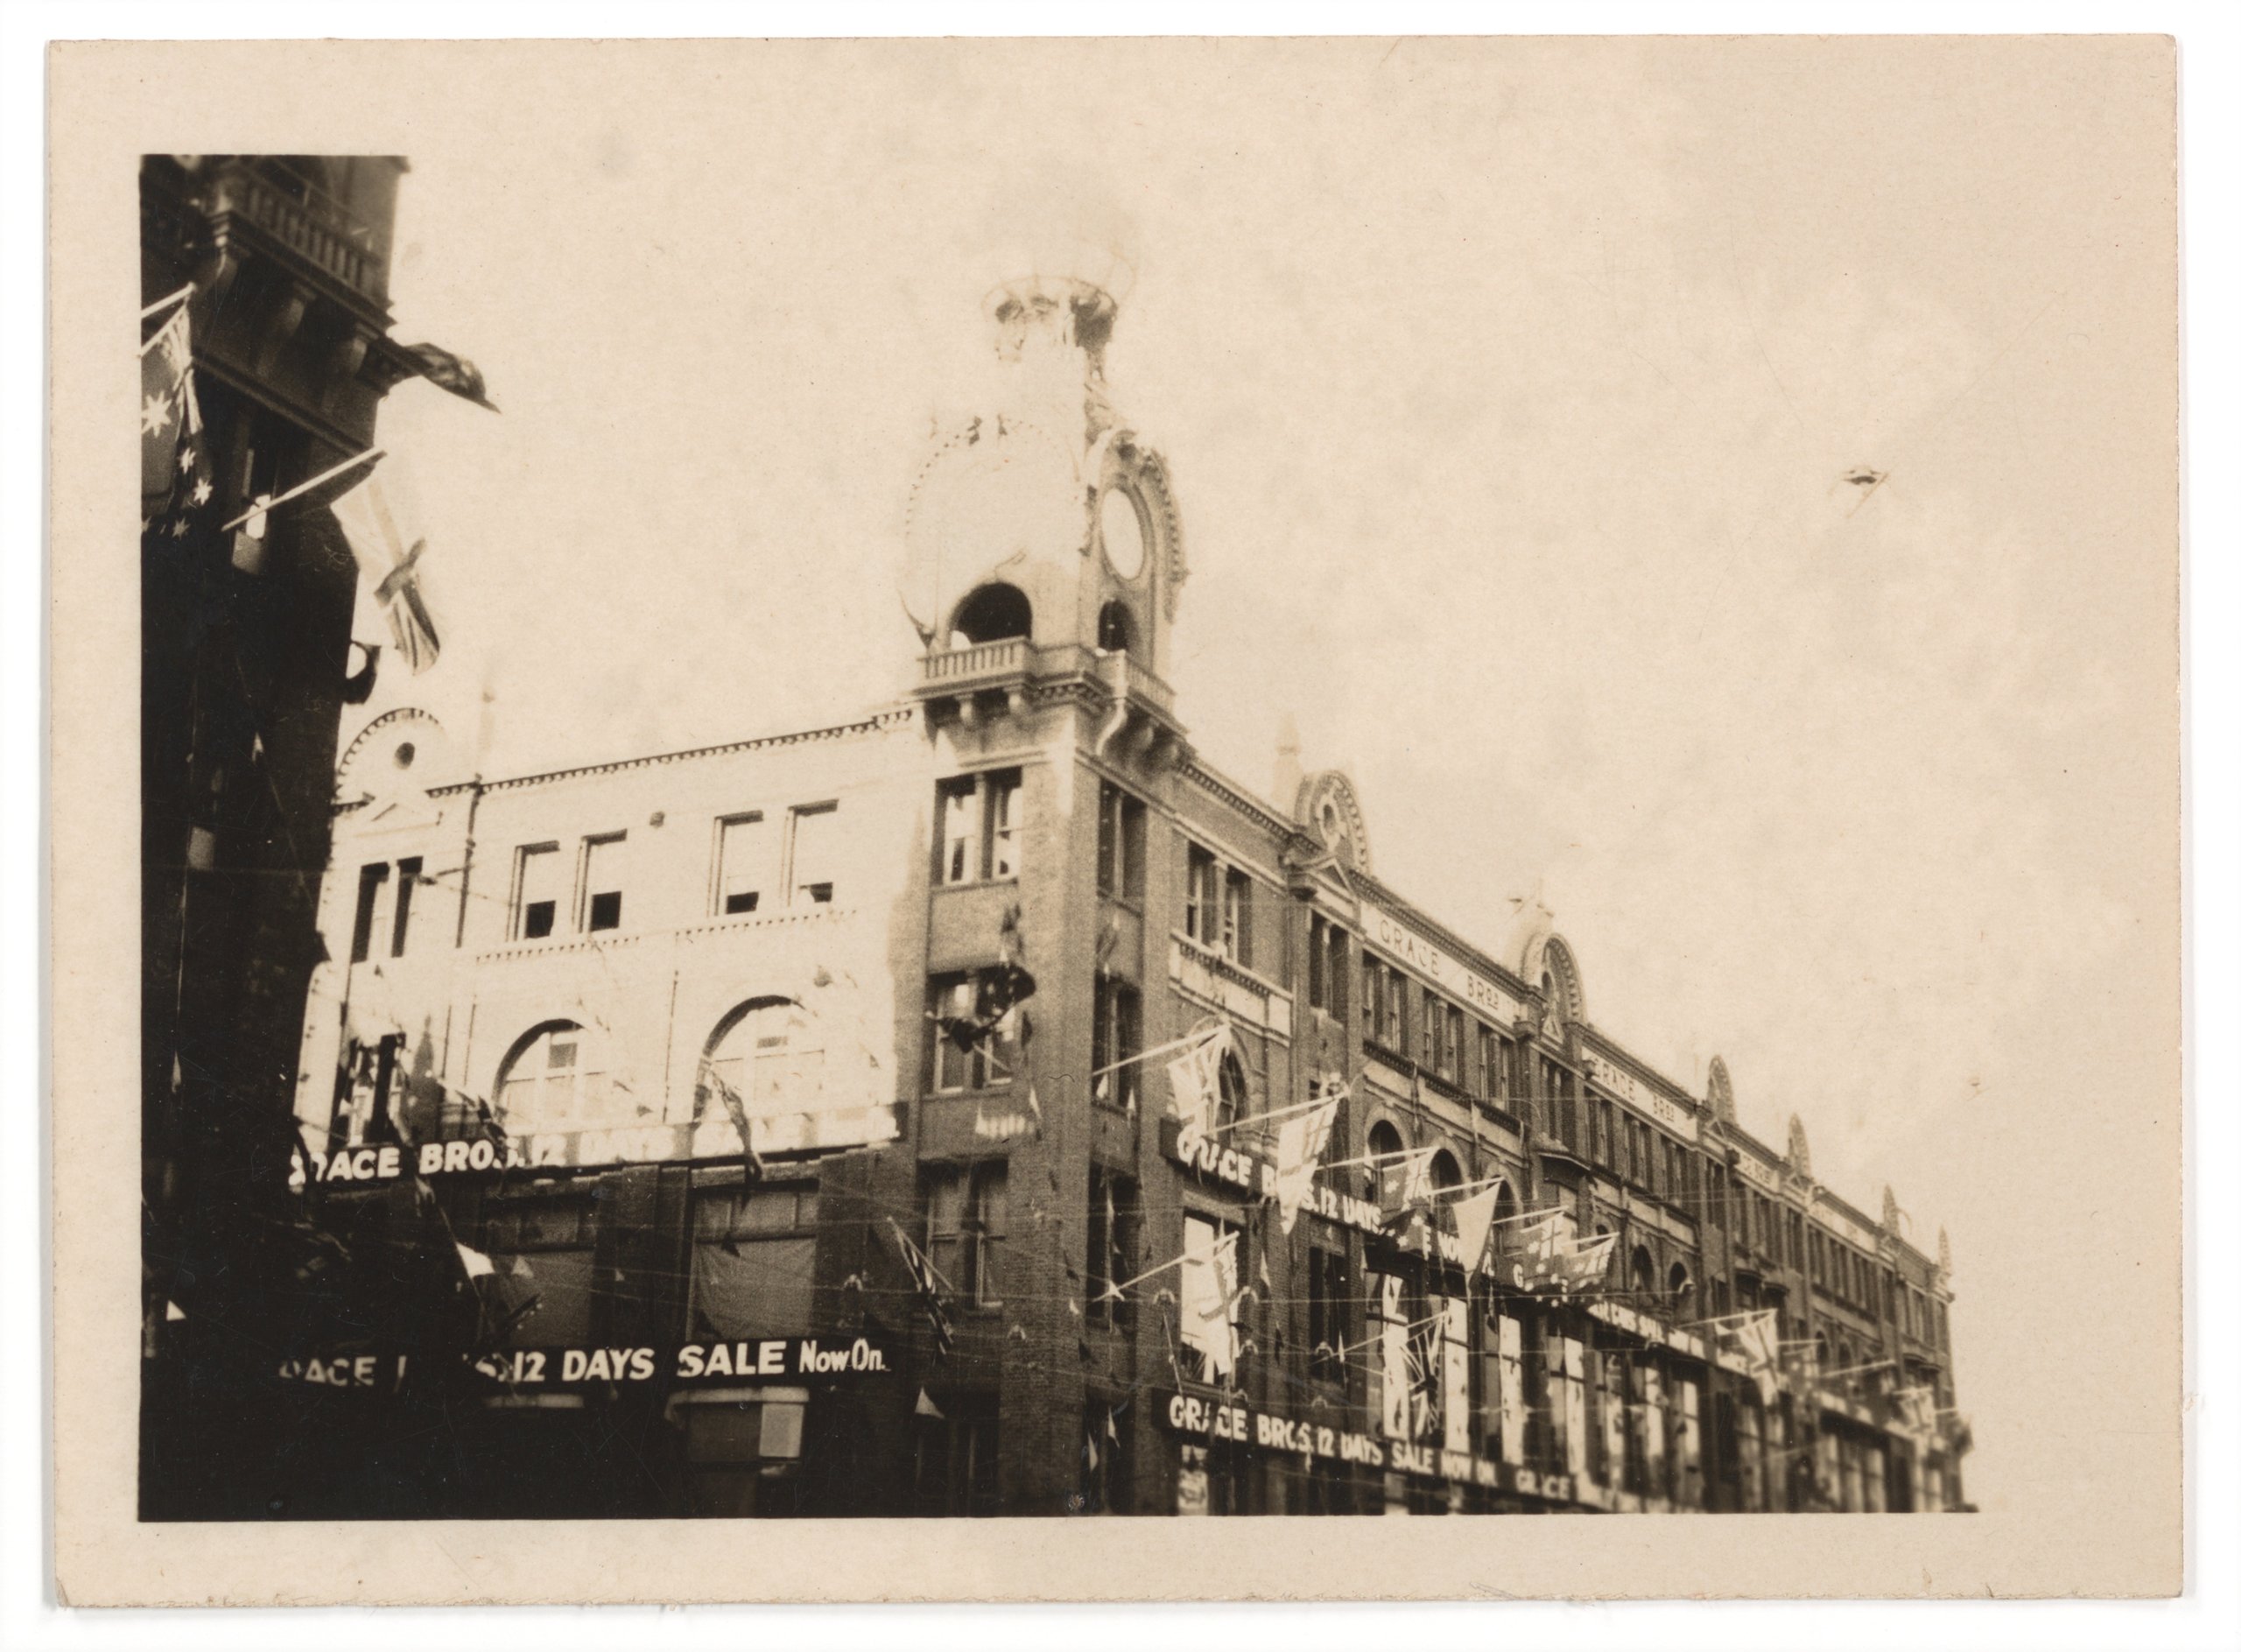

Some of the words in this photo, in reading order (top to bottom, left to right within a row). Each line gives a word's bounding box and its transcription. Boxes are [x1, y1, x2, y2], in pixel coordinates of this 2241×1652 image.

[562, 1347, 656, 1381] DAYS
[677, 1340, 787, 1378] SALE
[799, 1339, 848, 1374] Now
[1516, 1469, 1570, 1501] GRCE
